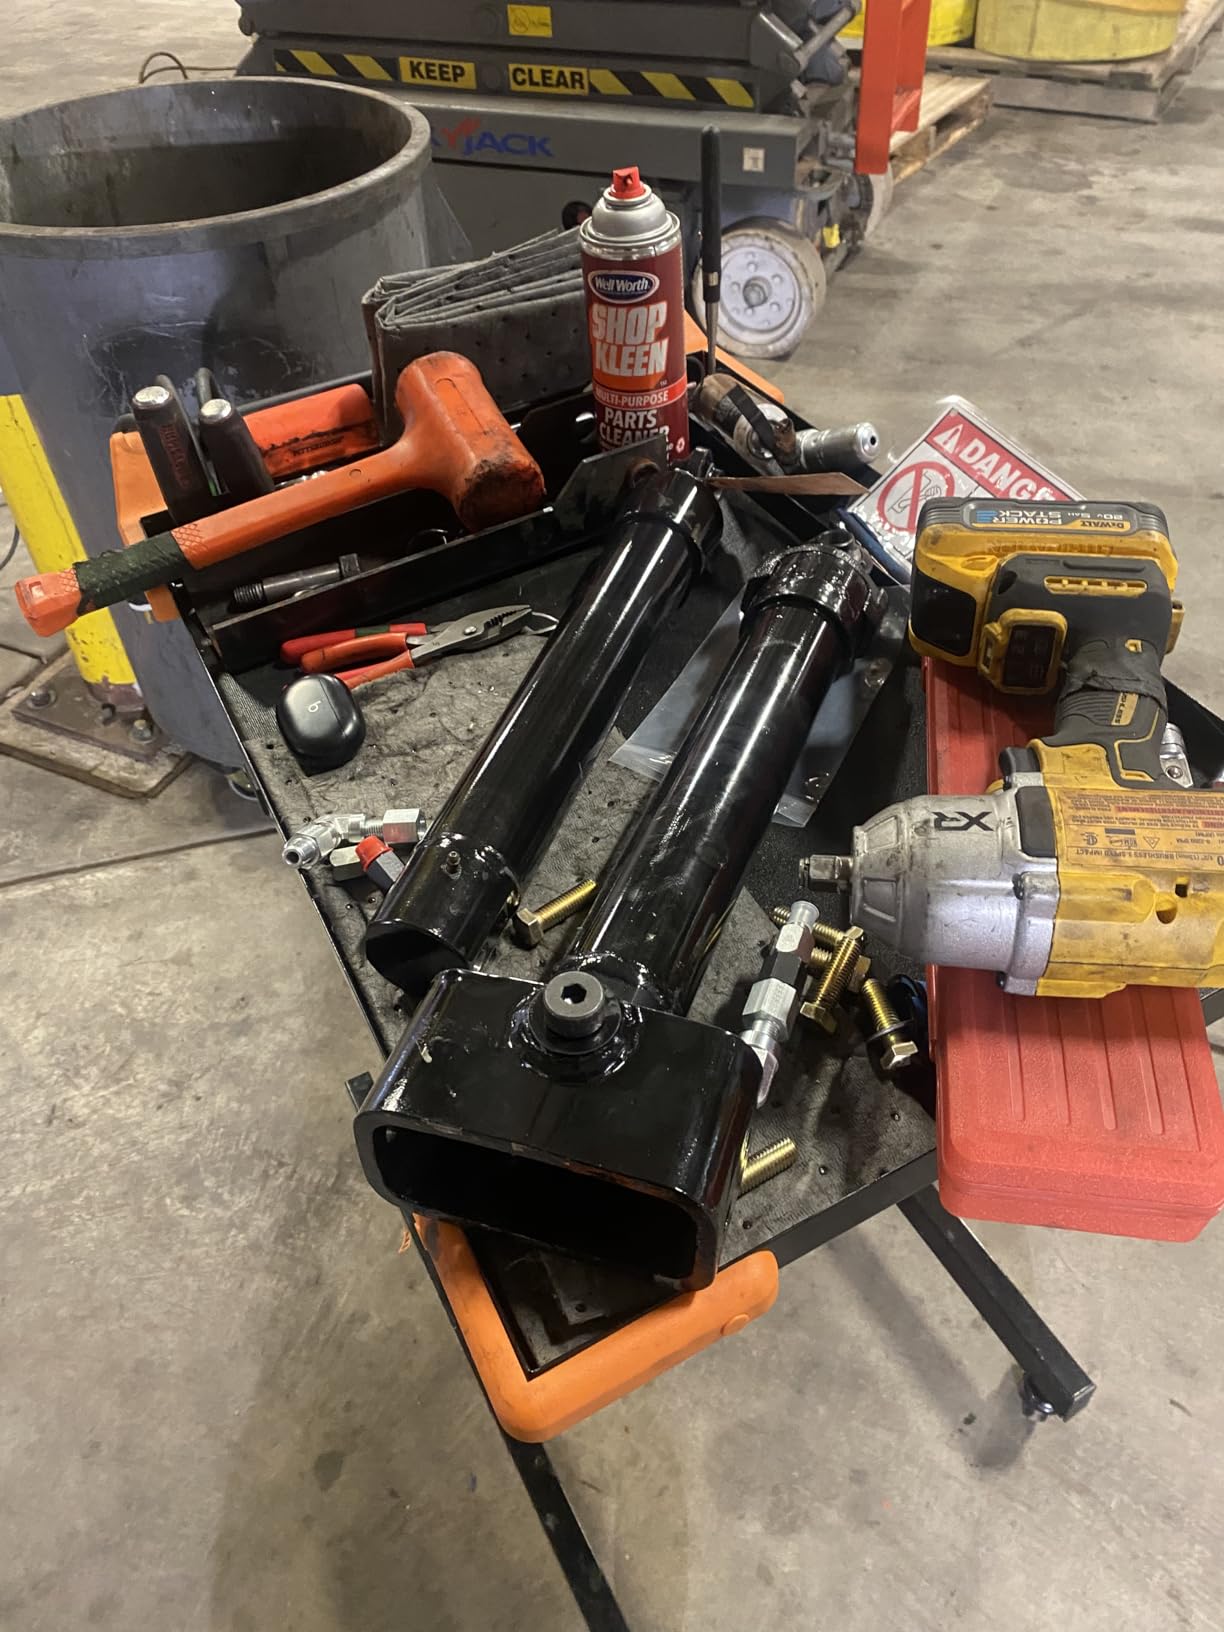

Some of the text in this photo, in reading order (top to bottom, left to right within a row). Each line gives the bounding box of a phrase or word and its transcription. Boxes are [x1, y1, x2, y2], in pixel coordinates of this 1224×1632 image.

[409, 60, 586, 90] KEEP CLEAR
[431, 116, 554, 157] YJACK
[595, 276, 649, 292] Well Worth
[592, 301, 668, 345] SHOP
[596, 336, 669, 376] KLEEN
[596, 387, 669, 407] MULTI-PURPOSE
[605, 406, 658, 429] PARTS
[958, 438, 1056, 500] DANG
[993, 516, 1062, 525] POWER
[999, 510, 1062, 518] STACK
[932, 811, 994, 831] XR
[1076, 848, 1103, 856] IMPACT
